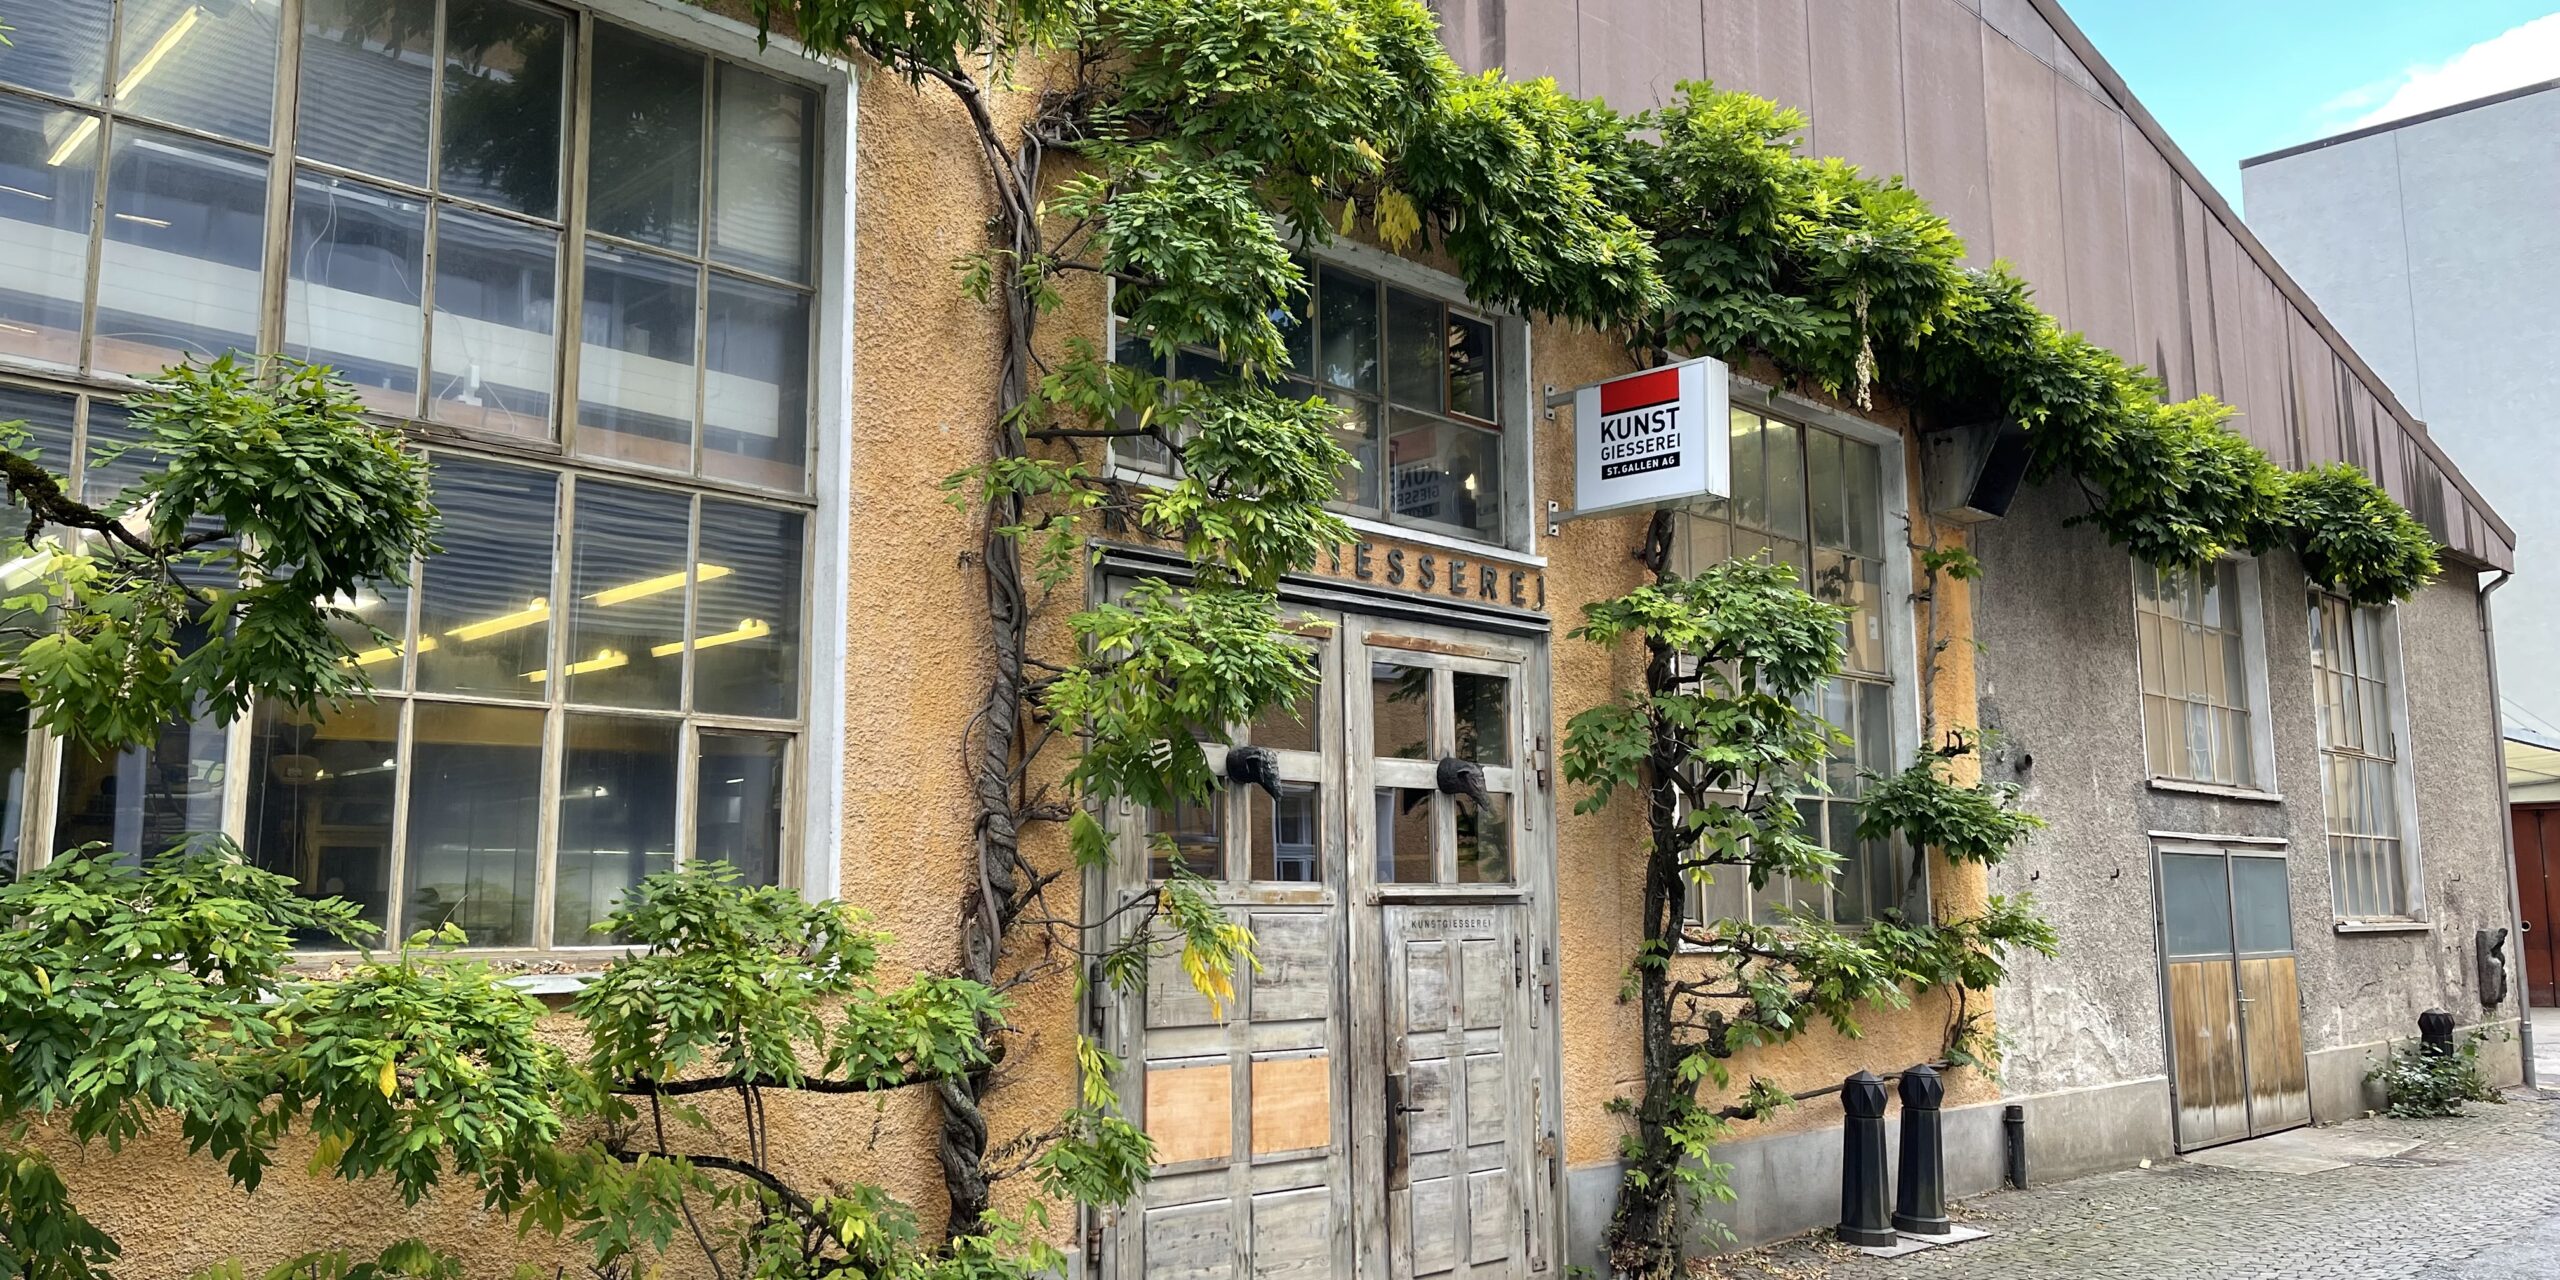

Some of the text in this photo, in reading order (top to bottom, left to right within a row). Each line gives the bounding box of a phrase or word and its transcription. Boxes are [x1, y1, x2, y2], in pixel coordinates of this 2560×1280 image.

[1601, 406, 1680, 443] KUNST
[1601, 432, 1680, 461] GIESSEREI
[1662, 456, 1675, 466] AG
[1411, 919, 1491, 929] KUNSTGIESSEREI
